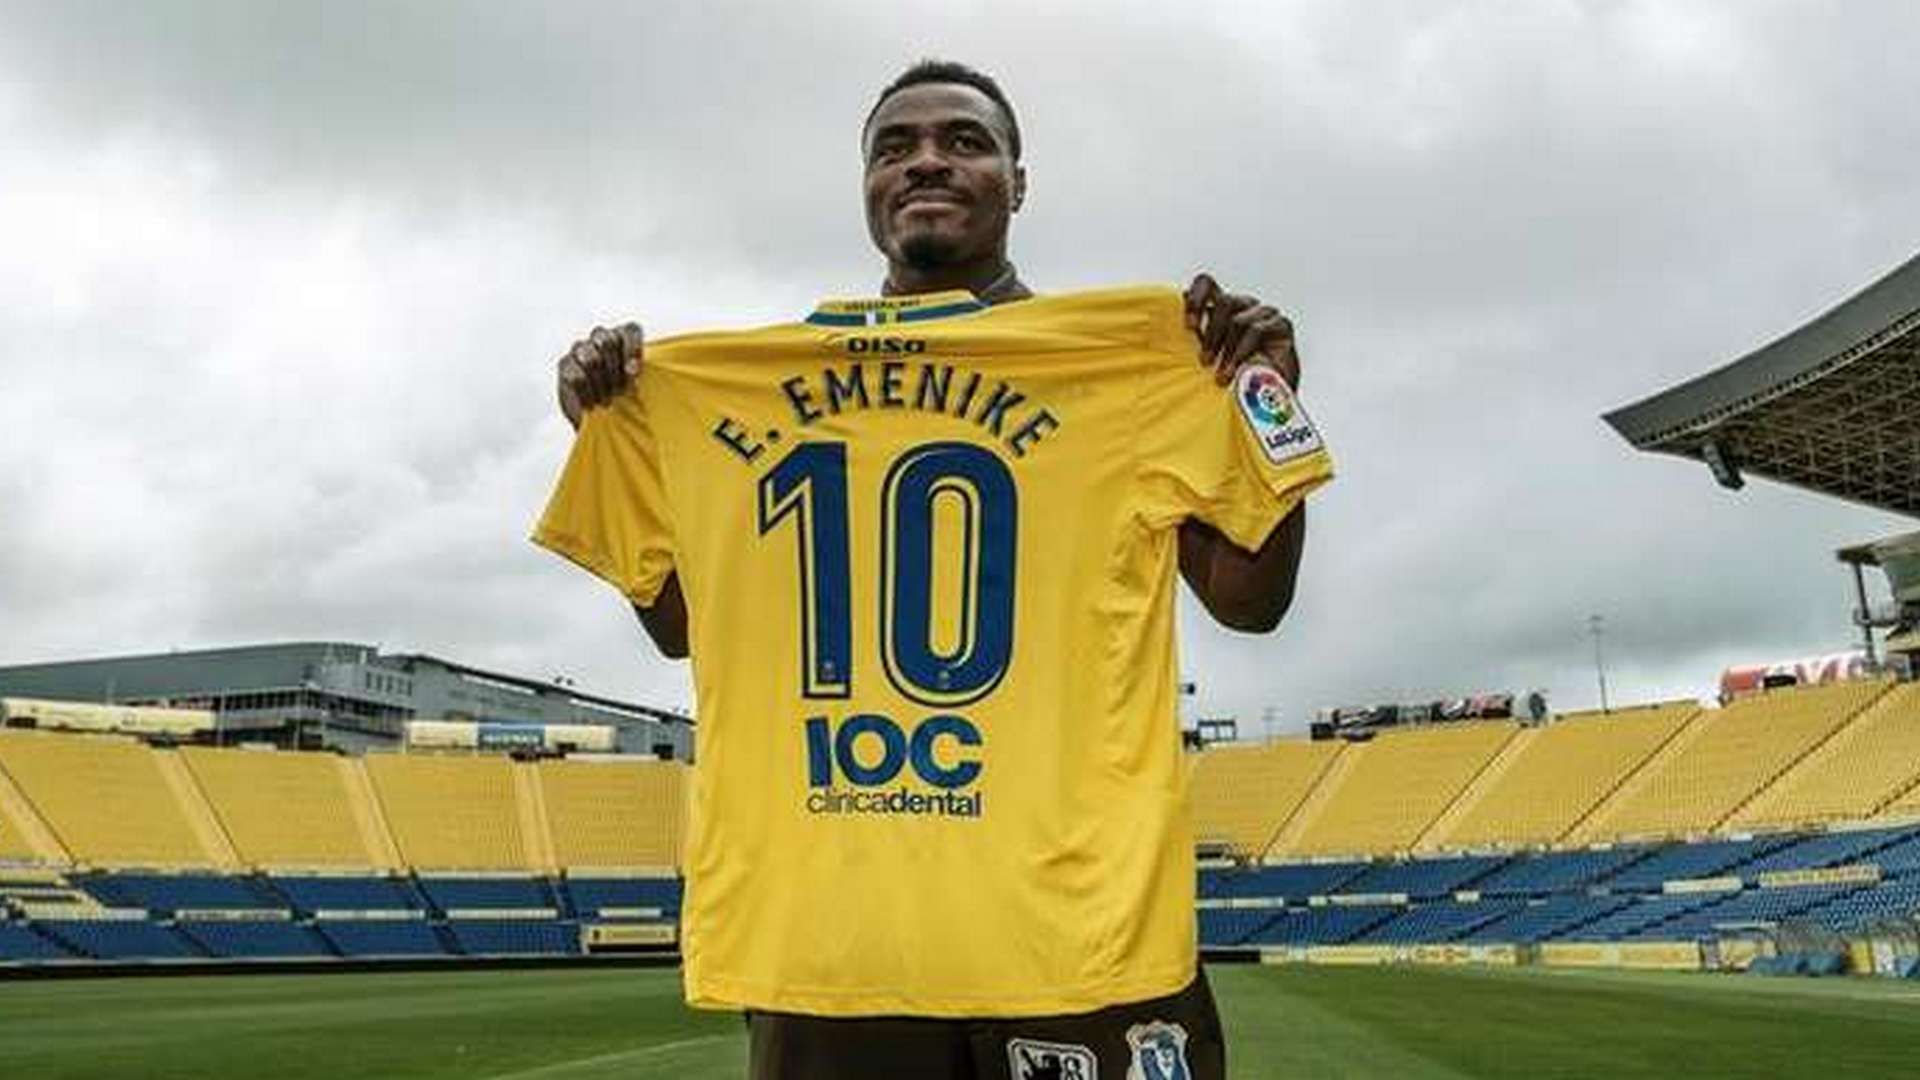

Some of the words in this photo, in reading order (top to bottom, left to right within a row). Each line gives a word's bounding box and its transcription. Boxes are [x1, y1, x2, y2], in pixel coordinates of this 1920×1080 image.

[713, 418, 780, 462] E.
[782, 361, 1060, 458] EMENIKE
[758, 441, 1018, 708] 10
[806, 714, 982, 787] IOC
